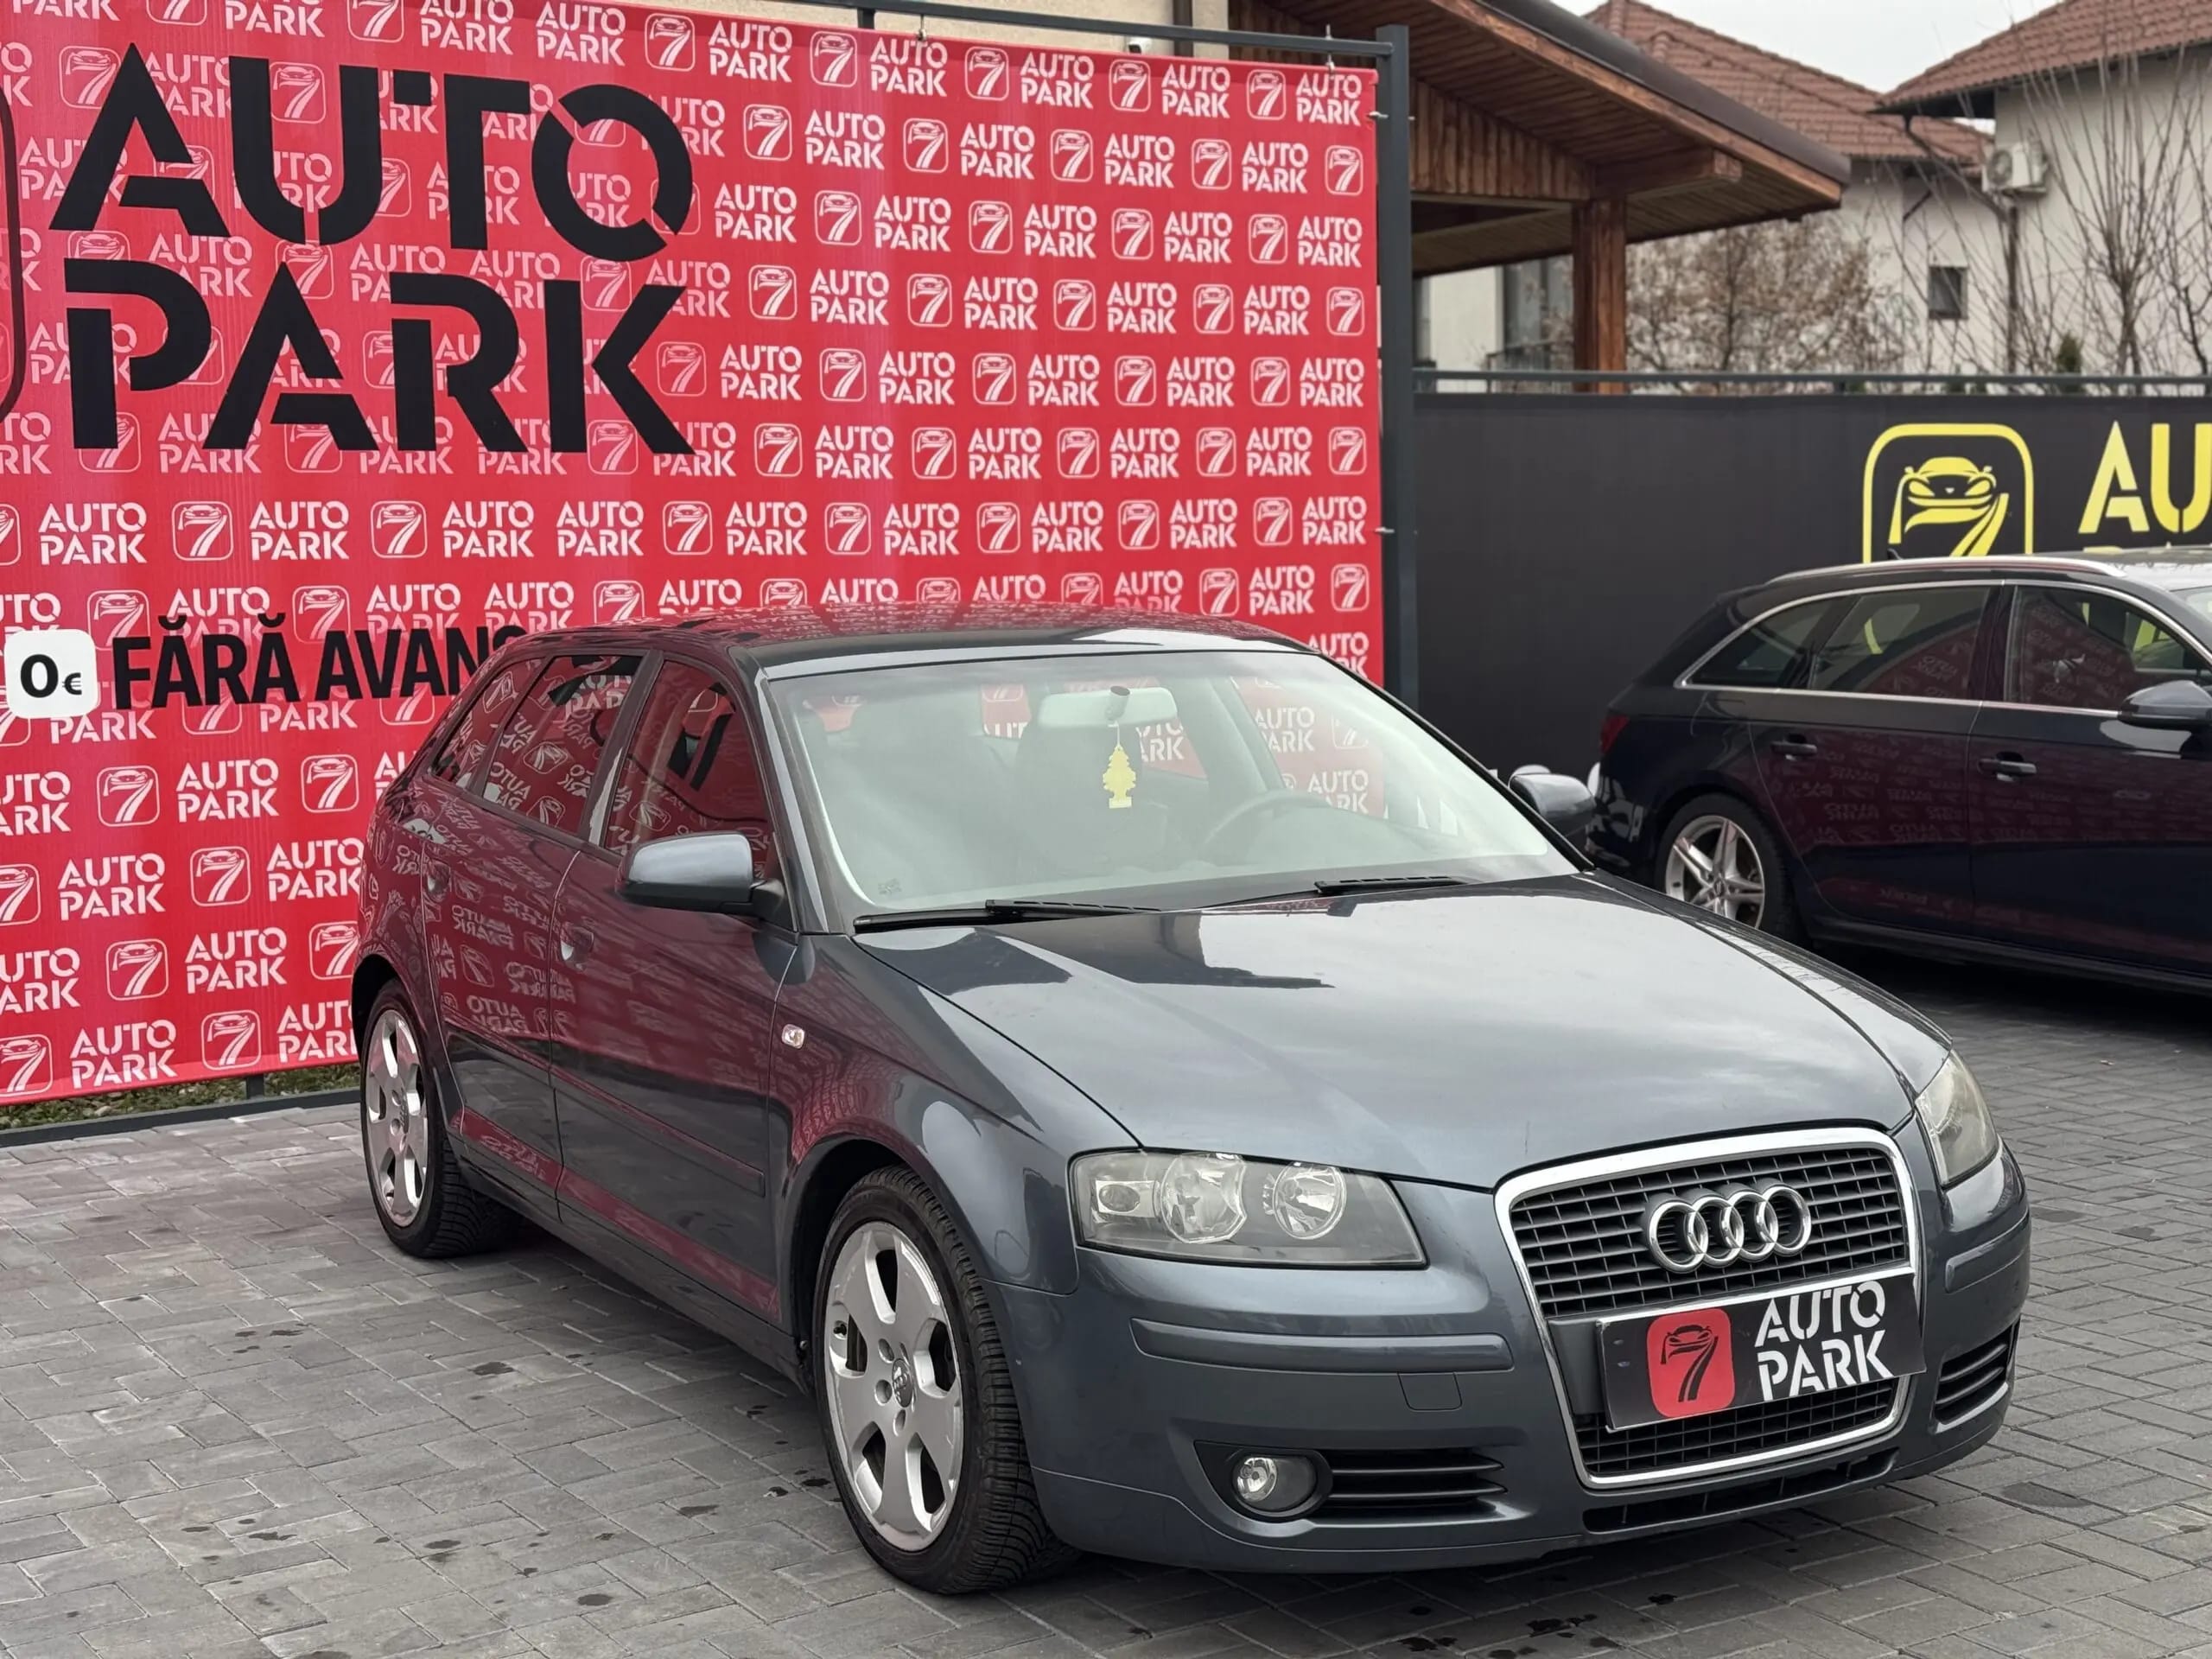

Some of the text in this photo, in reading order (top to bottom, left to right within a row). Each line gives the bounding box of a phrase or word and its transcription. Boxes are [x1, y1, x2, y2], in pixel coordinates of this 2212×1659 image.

[226, 3, 325, 37] PARK
[536, 2, 626, 35] AUTO
[421, 18, 512, 54] PARK
[537, 29, 625, 66] PARK
[709, 21, 792, 53] AUTO
[710, 48, 791, 82] PARK
[870, 38, 947, 68] AUTO
[1020, 52, 1094, 80] AUTO
[871, 64, 947, 97] PARK
[1021, 77, 1093, 108] PARK
[1161, 65, 1230, 92] AUTO
[1296, 73, 1362, 99] AUTO
[1162, 89, 1230, 118] PARK
[1297, 98, 1362, 125] PARK
[804, 110, 885, 142] AUTO
[960, 124, 1035, 152] AUTO
[49, 41, 693, 263] AUTO
[806, 137, 885, 170] PARK
[1104, 134, 1175, 162] AUTO
[1242, 142, 1308, 168] AUTO
[961, 149, 1034, 180] PARK
[1105, 159, 1173, 188] PARK
[1243, 167, 1308, 194] PARK
[715, 183, 797, 213] AUTO
[874, 195, 951, 225] AUTO
[715, 211, 796, 242] PARK
[1024, 204, 1096, 232] AUTO
[1164, 212, 1232, 238] AUTO
[1298, 216, 1362, 242] AUTO
[149, 233, 251, 265] AUTO
[874, 224, 951, 251] PARK
[1025, 230, 1096, 258] PARK
[1165, 236, 1231, 263] PARK
[350, 244, 445, 273] AUTO
[470, 251, 560, 279] AUTO
[1298, 240, 1361, 267] PARK
[646, 260, 730, 289] AUTO
[810, 269, 889, 298] AUTO
[963, 276, 1038, 303] AUTO
[1107, 282, 1177, 308] AUTO
[1243, 285, 1310, 311] AUTO
[811, 296, 888, 325] PARK
[965, 302, 1037, 330] PARK
[1108, 307, 1176, 334] PARK
[1244, 310, 1310, 335] PARK
[64, 257, 696, 456] PARK
[720, 345, 802, 372] AUTO
[878, 351, 955, 378] AUTO
[1027, 354, 1100, 380] AUTO
[1166, 357, 1235, 382] AUTO
[1300, 358, 1364, 383] AUTO
[721, 372, 802, 400] PARK
[880, 377, 954, 404] PARK
[1028, 379, 1100, 405] PARK
[1167, 382, 1234, 406] PARK
[1300, 382, 1364, 406] PARK
[815, 425, 893, 452] AUTO
[968, 428, 1042, 453] AUTO
[1110, 428, 1179, 452] AUTO
[1246, 427, 1312, 452] AUTO
[161, 444, 260, 473] PARK
[360, 446, 453, 474] PARK
[478, 445, 567, 474] PARK
[653, 449, 736, 477] PARK
[816, 452, 893, 479] PARK
[969, 454, 1041, 480] PARK
[1111, 453, 1179, 478] PARK
[1247, 451, 1312, 475] PARK
[39, 503, 146, 532] AUTO
[250, 501, 349, 529] AUTO
[442, 501, 534, 528] AUTO
[556, 501, 644, 528] AUTO
[726, 502, 807, 528] AUTO
[883, 503, 959, 529] AUTO
[1032, 500, 1103, 526] AUTO
[1170, 499, 1237, 524] AUTO
[1302, 496, 1366, 521] AUTO
[251, 531, 349, 560] PARK
[444, 530, 534, 557] PARK
[557, 529, 643, 556] PARK
[727, 529, 806, 555] PARK
[885, 530, 958, 556] PARK
[1033, 526, 1103, 553] PARK
[1171, 523, 1237, 549] PARK
[1303, 520, 1366, 544] PARK
[41, 534, 146, 565] PARK
[820, 578, 899, 605] AUTO
[974, 575, 1046, 599] AUTO
[1115, 570, 1183, 595] AUTO
[1249, 565, 1314, 590] AUTO
[167, 587, 270, 617] AUTO
[366, 583, 461, 612] AUTO
[484, 582, 574, 609] AUTO
[658, 579, 741, 606] AUTO
[1250, 589, 1314, 615] PARK
[112, 612, 301, 710] FĂRĂ
[314, 625, 528, 702] AVAN
[50, 709, 156, 744] PARK
[261, 701, 357, 732] PARK
[176, 758, 278, 791] AUTO
[1307, 769, 1369, 794] AUTO
[178, 788, 278, 822] PARK
[267, 837, 364, 872] AUTO
[58, 854, 164, 889] AUTO
[268, 867, 361, 902] PARK
[60, 884, 164, 920] PARK
[186, 927, 286, 963] AUTO
[0, 947, 80, 982] UTO
[187, 957, 286, 994] PARK
[0, 977, 80, 1015] ARK
[276, 1000, 353, 1034] AUT
[70, 1020, 175, 1058] AUTO
[73, 1050, 177, 1089] PARK
[1755, 1279, 1885, 1348] AUTO
[1756, 1329, 1893, 1402] PARK
